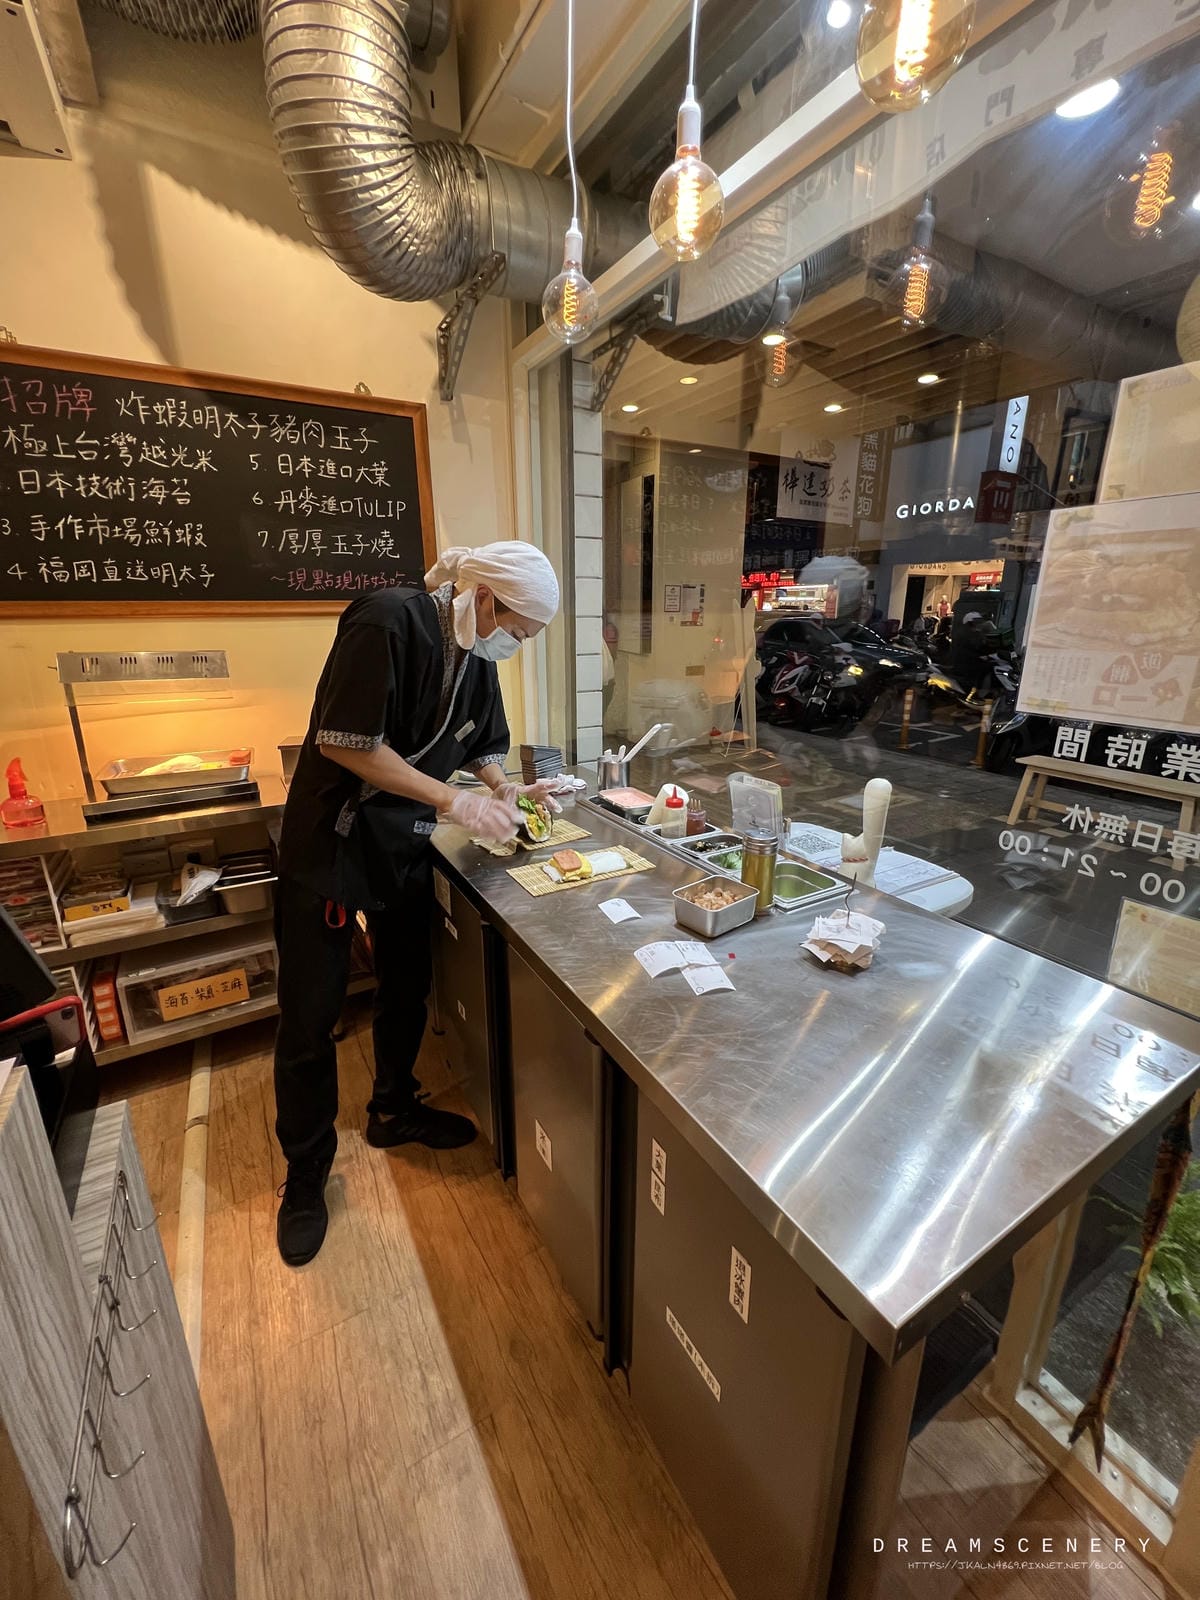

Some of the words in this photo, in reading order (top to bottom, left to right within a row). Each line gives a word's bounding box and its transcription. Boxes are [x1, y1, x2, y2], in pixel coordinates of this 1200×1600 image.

[0, 376, 97, 422] 招牌
[1, 423, 218, 472] 極上台灣越光米
[18, 469, 191, 505] 日本技術海苔
[277, 453, 391, 487] 日本進口大葉
[29, 512, 208, 548] 手作市場鮮蝦
[37, 556, 216, 588] 福岡直送明太子
